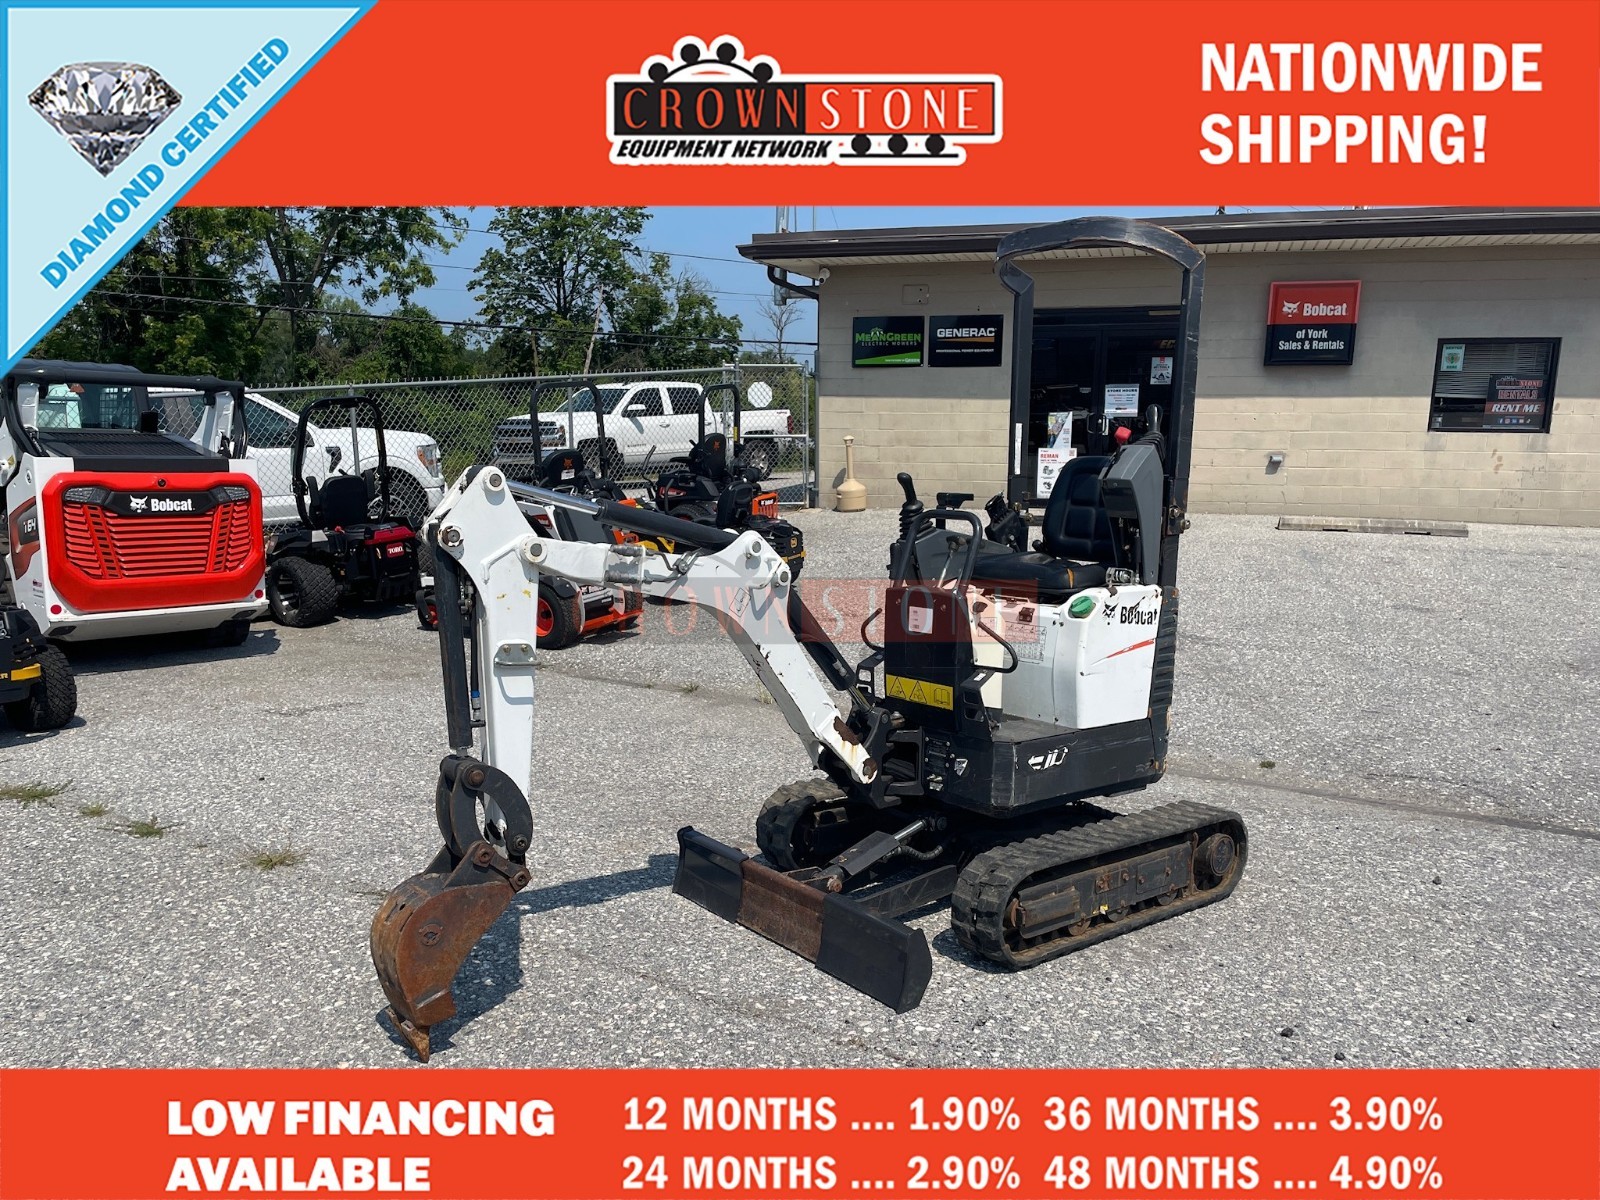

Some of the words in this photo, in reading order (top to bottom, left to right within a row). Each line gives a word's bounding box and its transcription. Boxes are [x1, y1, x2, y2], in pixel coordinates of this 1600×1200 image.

[1303, 303, 1347, 316] Bobcat
[936, 327, 996, 338] GENERAC
[1296, 329, 1306, 339] of
[1307, 329, 1328, 339] York
[1278, 340, 1302, 350] Sales
[1303, 340, 1311, 350] &
[1312, 340, 1345, 350] Rentals
[1491, 403, 1522, 413] RENT
[1522, 404, 1542, 413] ME
[150, 498, 193, 512] Bobcat
[1120, 605, 1158, 625] Bobcat
